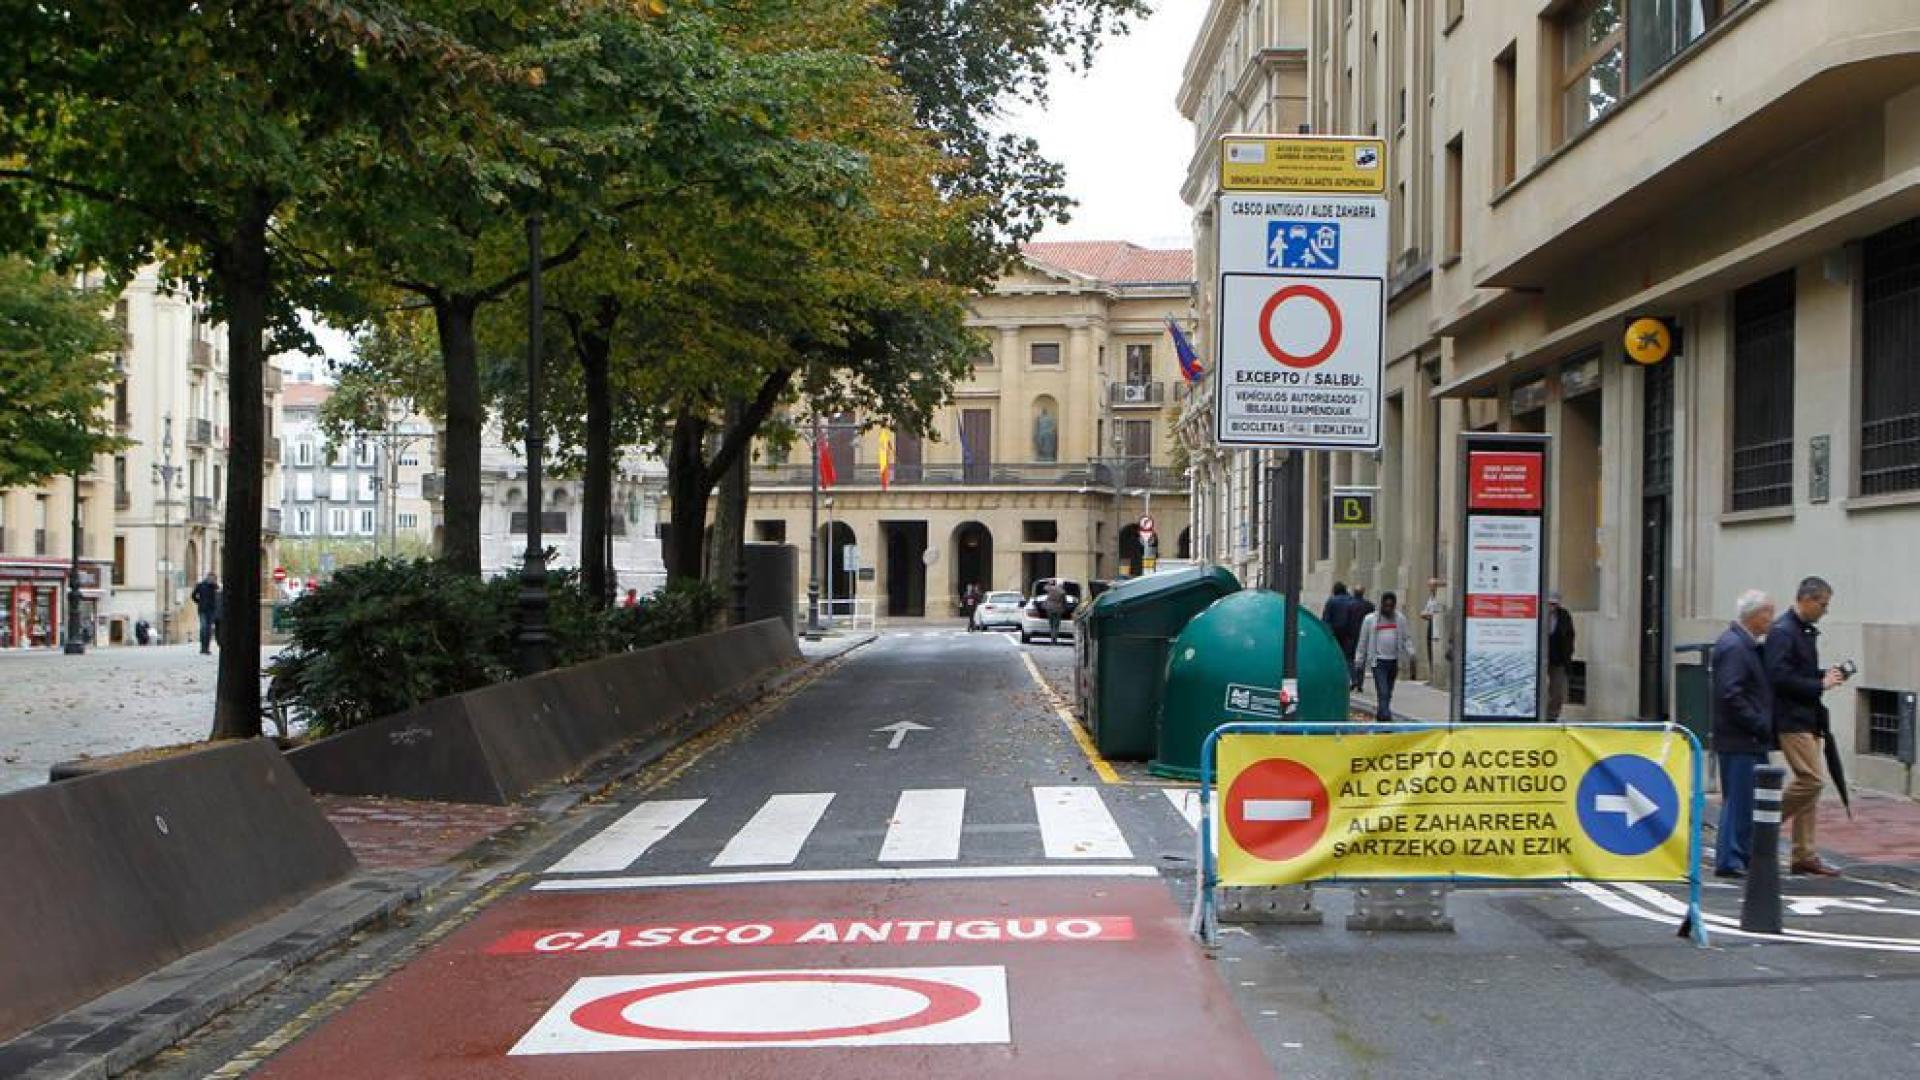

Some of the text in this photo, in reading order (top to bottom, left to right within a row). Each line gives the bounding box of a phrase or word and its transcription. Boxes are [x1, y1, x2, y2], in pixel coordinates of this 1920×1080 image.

[1231, 202, 1262, 216] CASCO
[1264, 203, 1305, 217] ANTIGUO
[1310, 204, 1333, 217] ALDE
[1335, 205, 1376, 218] ZAHARRA
[1236, 370, 1300, 385] EXCEPTO
[1314, 373, 1364, 387] SALBU:
[1291, 393, 1357, 404] AUTORIZADOS
[1231, 422, 1364, 435] BICICLETAS BIZIKLETAK
[1350, 750, 1558, 775] EXCEPTO ACCESO
[1339, 774, 1568, 797] AL CASCO ANTIGUO
[1348, 812, 1558, 834] ALDE ZAHARRERA
[1333, 837, 1572, 858] SARTZEKO IZAN EZIK
[532, 918, 1103, 951] CASCO ANTIGUO
